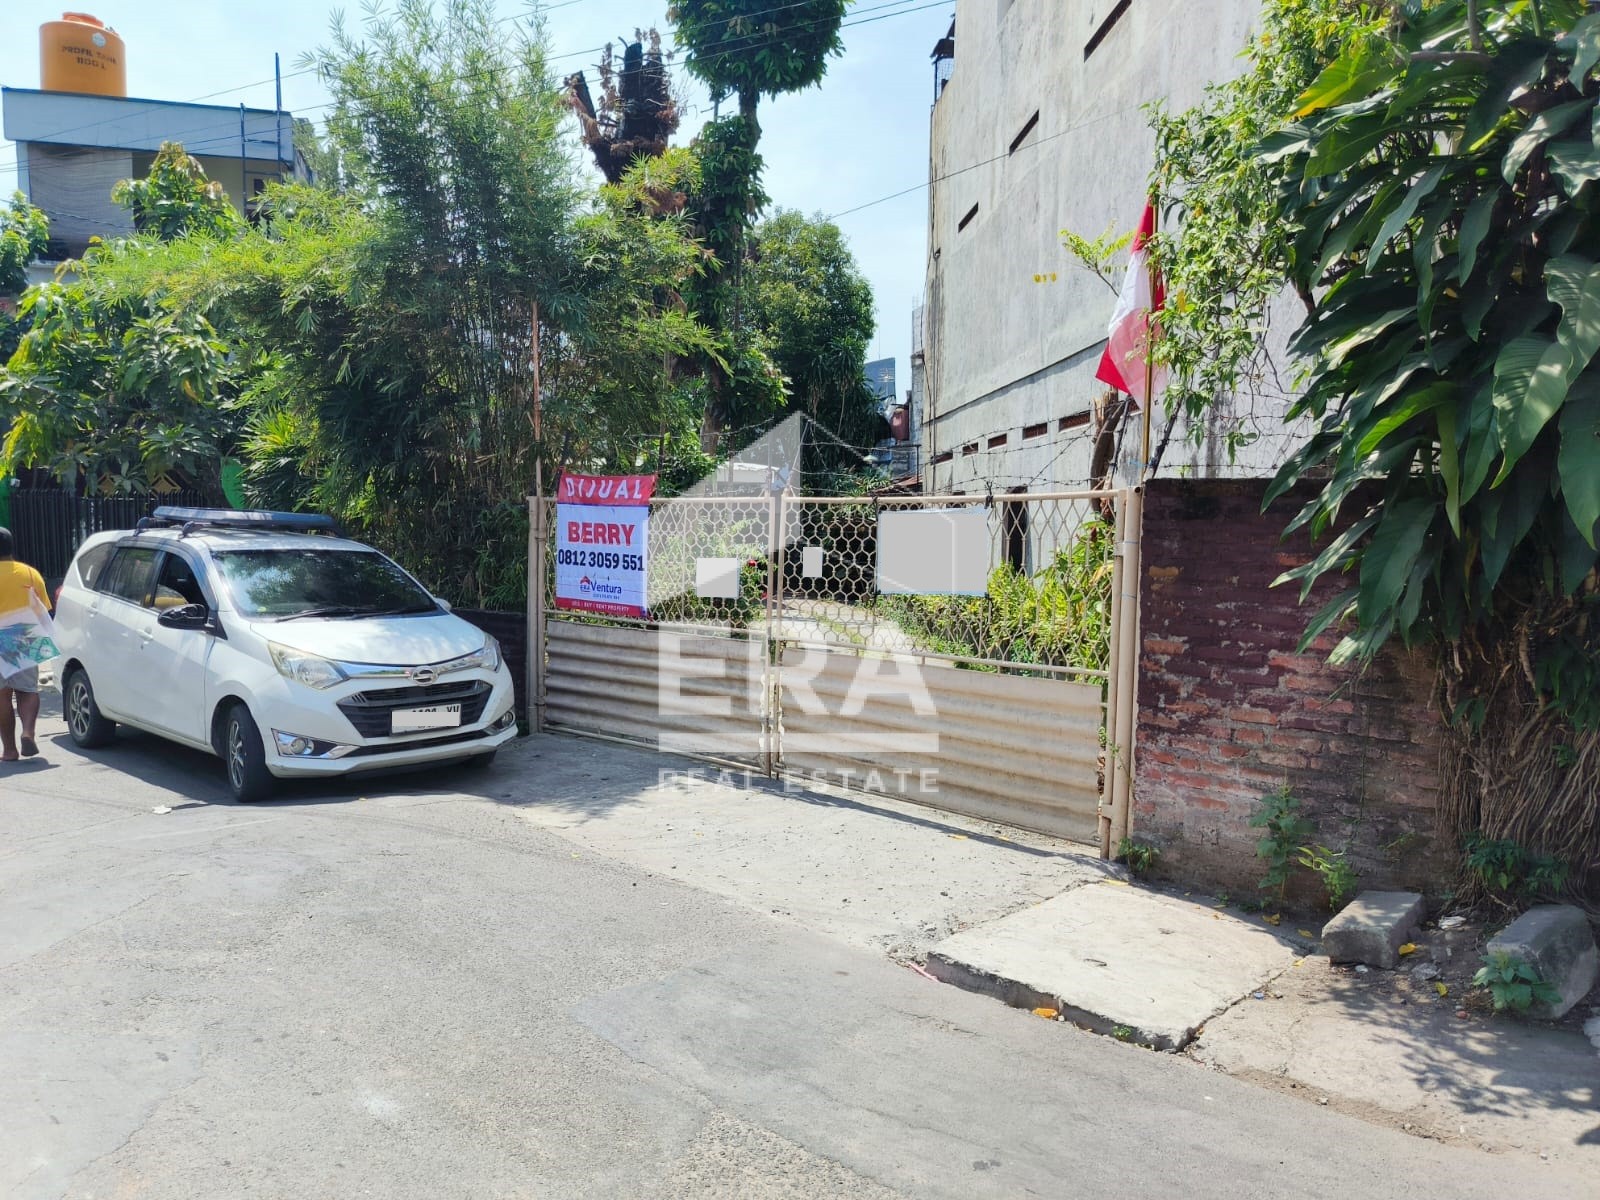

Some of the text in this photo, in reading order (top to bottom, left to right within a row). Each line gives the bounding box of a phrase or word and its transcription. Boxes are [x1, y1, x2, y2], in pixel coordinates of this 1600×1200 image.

[565, 477, 642, 498] DIJUAL
[568, 521, 635, 546] BERRY
[558, 548, 645, 572] 0812 3059 551
[591, 580, 622, 594] Ventura
